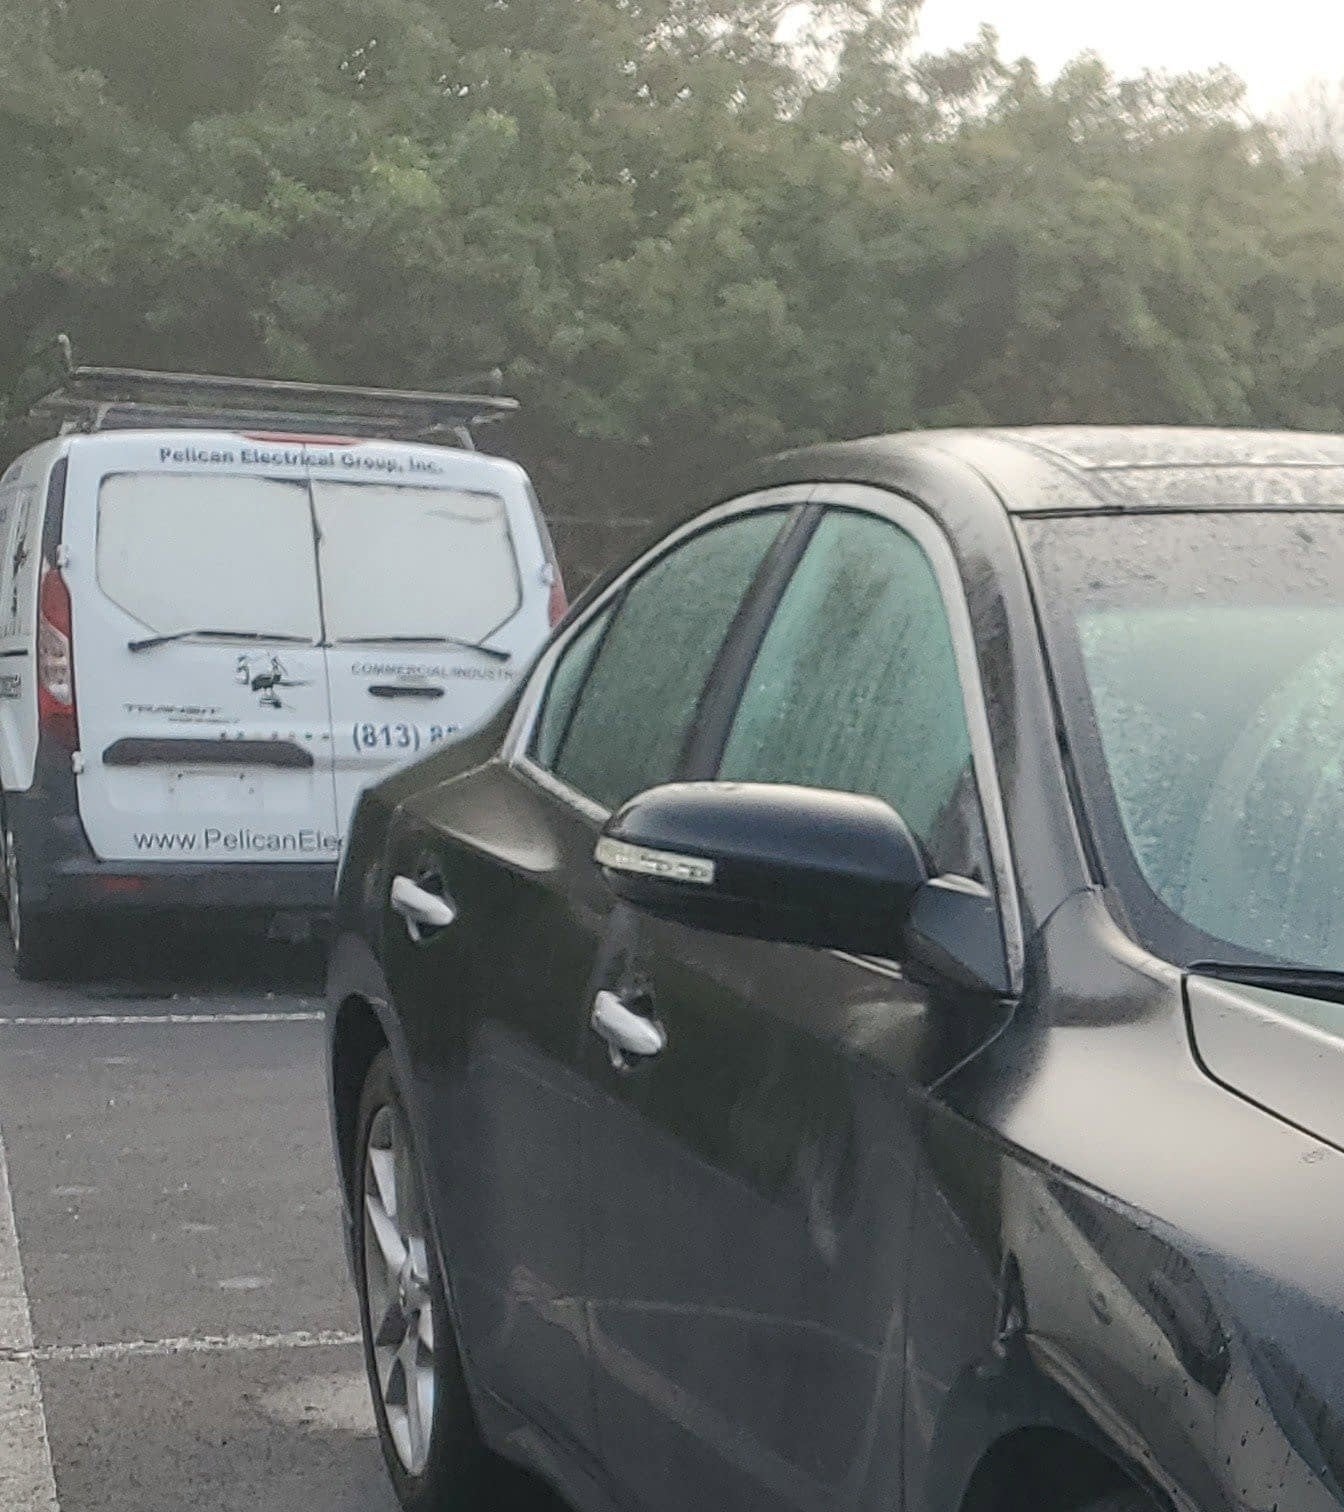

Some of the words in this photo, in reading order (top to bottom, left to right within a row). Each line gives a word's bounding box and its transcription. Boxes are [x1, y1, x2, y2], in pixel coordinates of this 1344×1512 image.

[158, 448, 235, 464] Pelican
[240, 449, 335, 467] Electrical
[341, 451, 404, 473] Group,
[408, 454, 444, 473] Inc.
[353, 723, 421, 751] (813)
